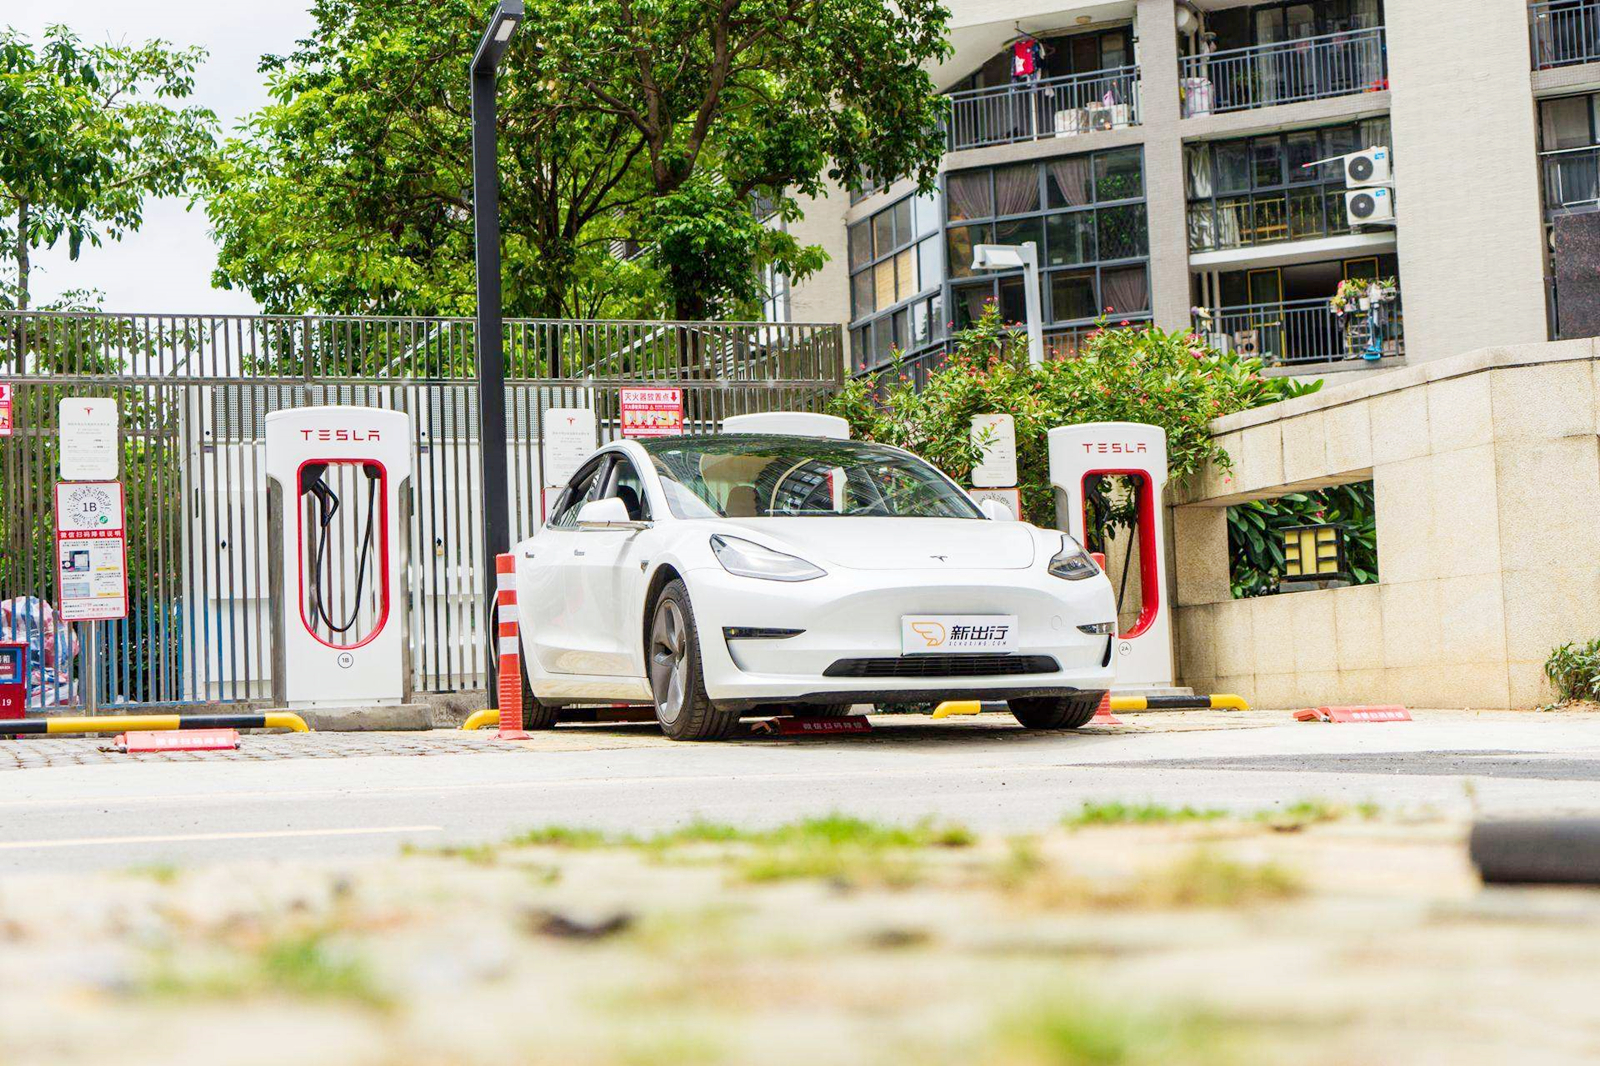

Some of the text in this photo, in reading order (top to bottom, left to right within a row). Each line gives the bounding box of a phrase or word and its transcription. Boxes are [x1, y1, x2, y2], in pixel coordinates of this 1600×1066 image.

[624, 392, 669, 402] 灭火器放置点
[300, 429, 380, 441] TESLA
[1082, 443, 1147, 453] TESLA
[82, 502, 97, 512] 1B
[950, 625, 1009, 640] 新出行
[0, 698, 12, 707] 19
